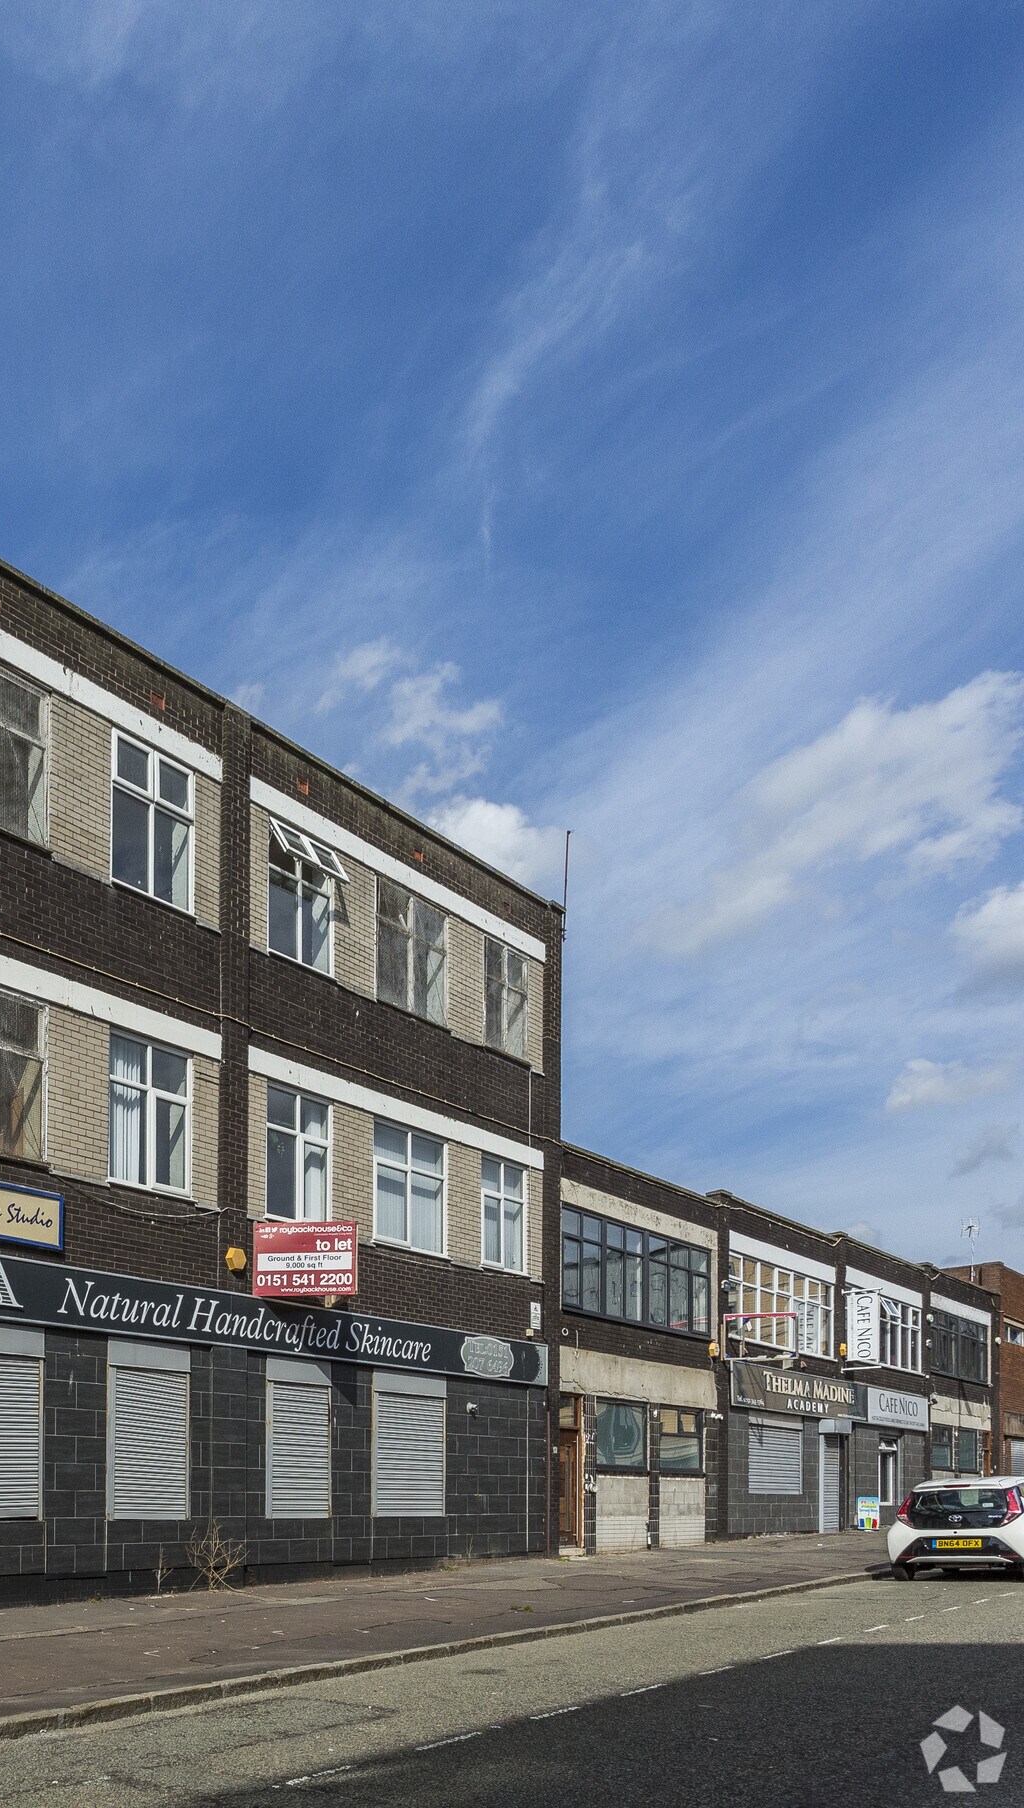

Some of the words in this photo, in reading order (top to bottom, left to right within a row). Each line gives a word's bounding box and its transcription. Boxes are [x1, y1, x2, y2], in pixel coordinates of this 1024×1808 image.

[7, 1203, 53, 1229] Studio
[316, 1238, 330, 1251] to
[334, 1238, 353, 1251] let
[256, 1274, 288, 1287] 0151
[292, 1273, 315, 1286] 541
[319, 1273, 353, 1286] 2200
[280, 1286, 352, 1294] www.roybackhouse.com
[57, 1278, 184, 1328] Natural
[186, 1297, 342, 1352] Handcrafted
[345, 1322, 432, 1362] Skincare
[856, 1296, 873, 1324] CAFE
[856, 1327, 873, 1358] NICO
[763, 1370, 811, 1398] THELMA
[813, 1380, 855, 1404] MADINE
[787, 1398, 829, 1413] ACADEMY
[938, 1539, 960, 1547] BN64
